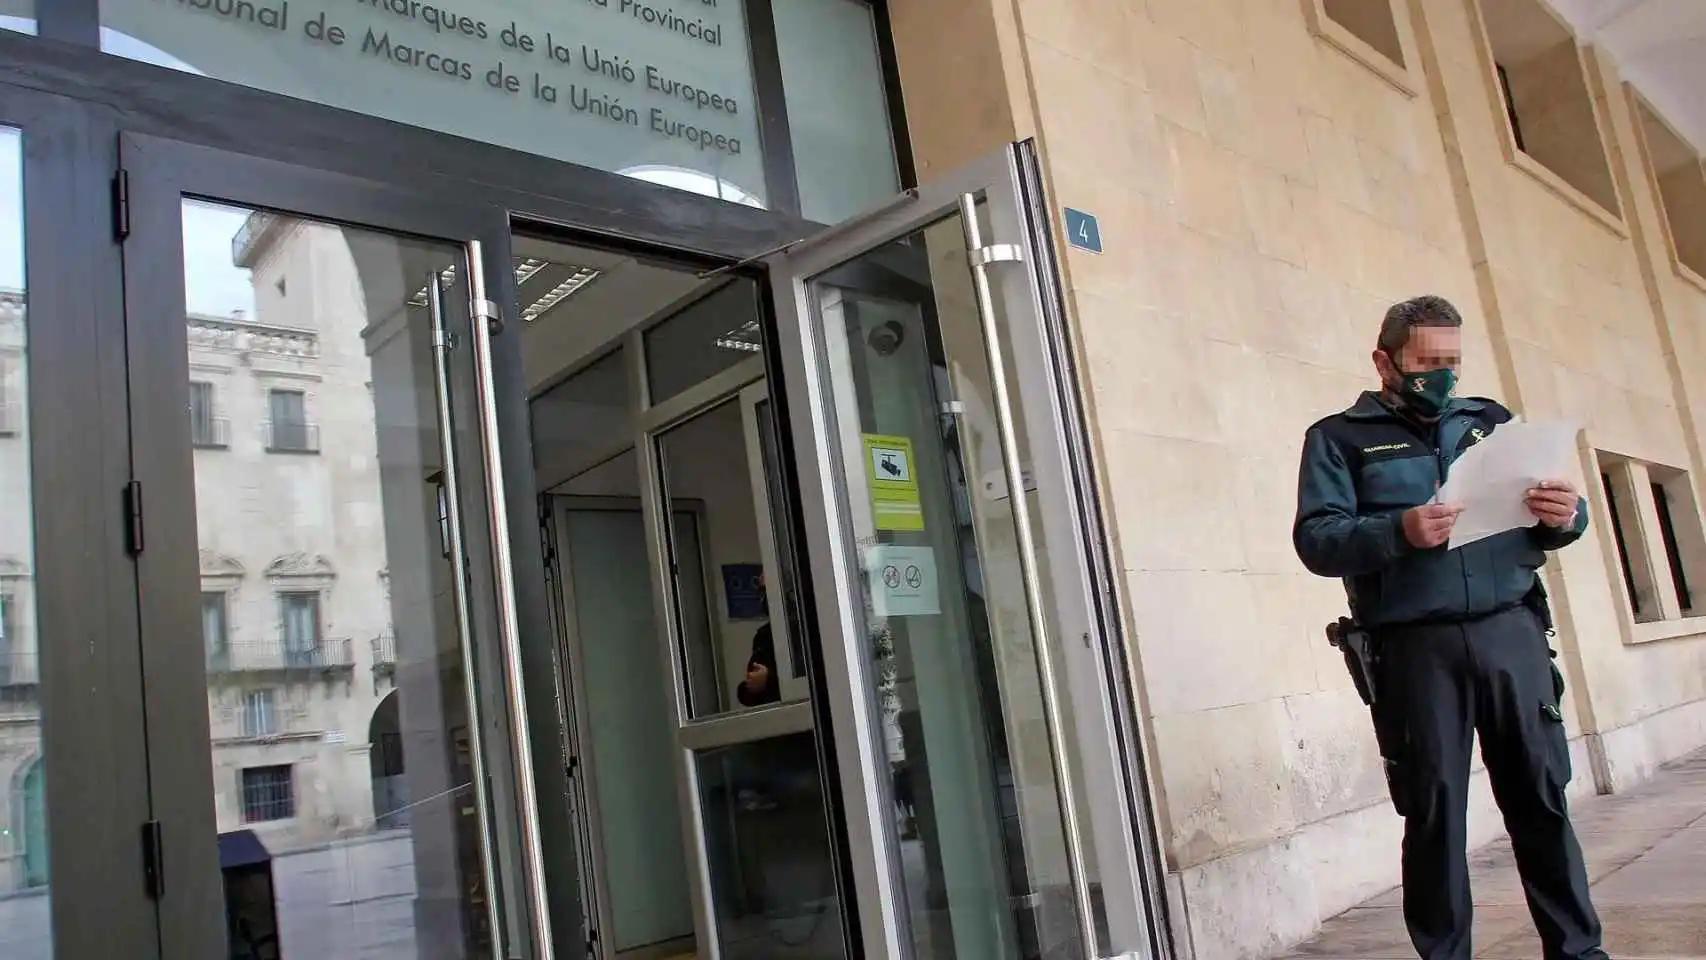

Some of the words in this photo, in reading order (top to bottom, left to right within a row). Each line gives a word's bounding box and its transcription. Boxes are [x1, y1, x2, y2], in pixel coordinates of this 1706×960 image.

[620, 0, 723, 46] Provincial
[304, 12, 346, 46] de
[361, 26, 473, 81] Marcas
[486, 62, 520, 93] de
[534, 73, 557, 103] la
[570, 85, 638, 126] Unión
[649, 107, 742, 154] Europea
[501, 22, 535, 53] de
[546, 33, 571, 65] la
[582, 45, 635, 83] Unió
[645, 65, 738, 114] Europea
[1079, 219, 1088, 243] 4
